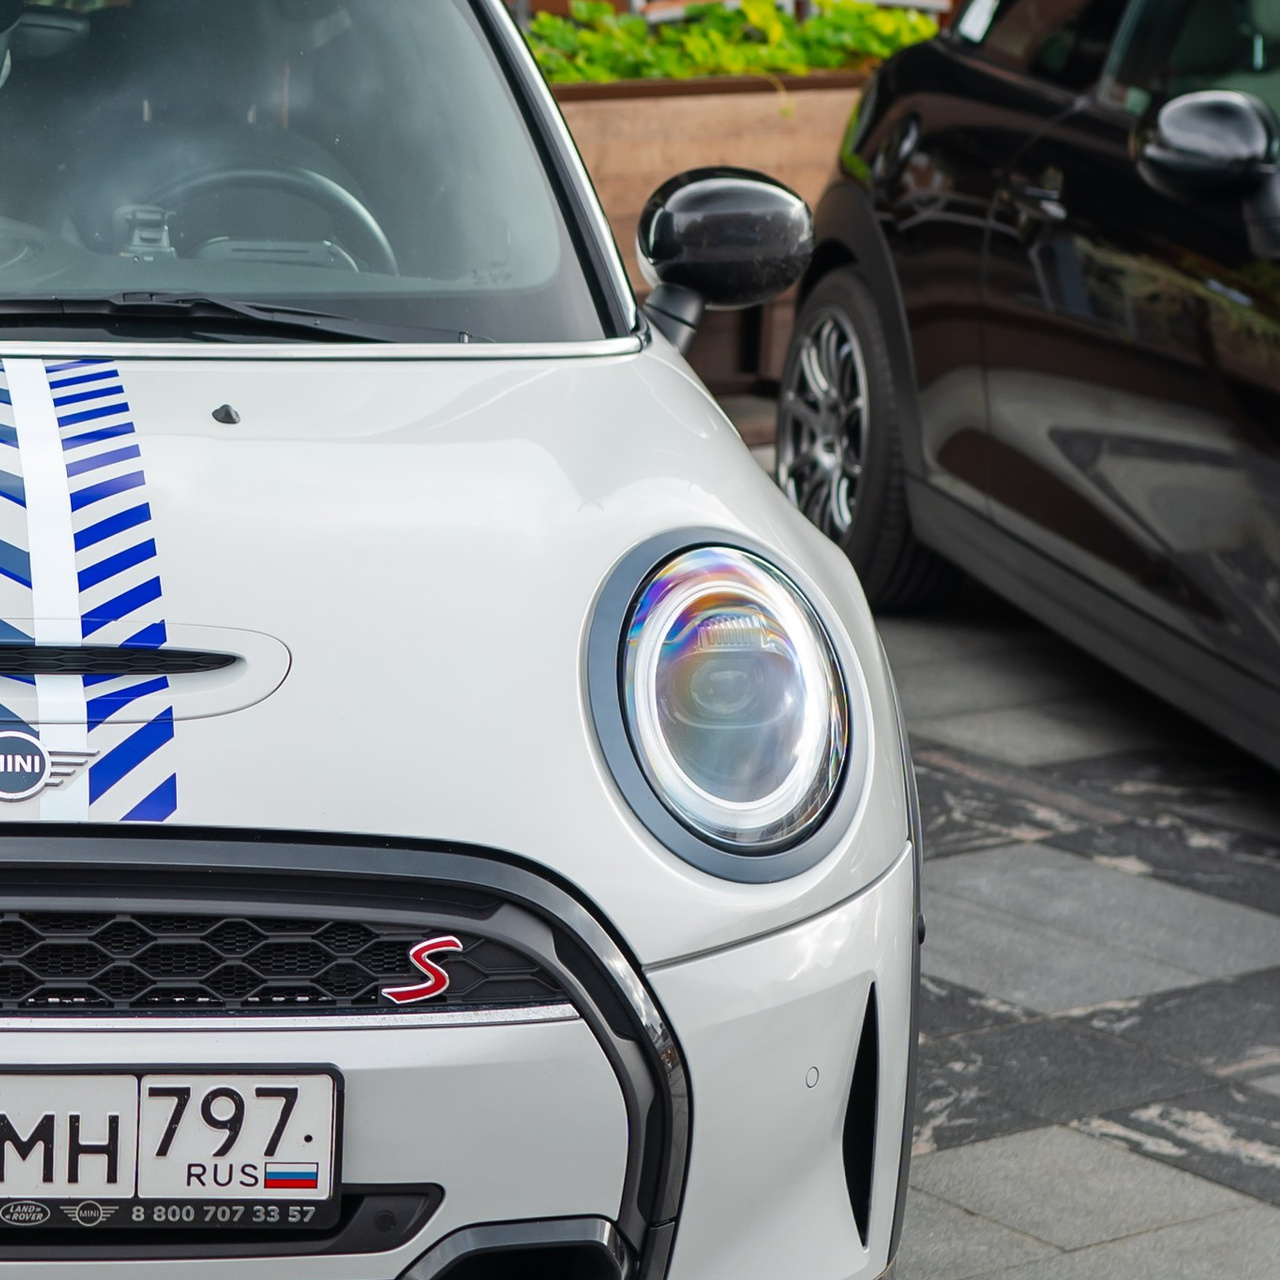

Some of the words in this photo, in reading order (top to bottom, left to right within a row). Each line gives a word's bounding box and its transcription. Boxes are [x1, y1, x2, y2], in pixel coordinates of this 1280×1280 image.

[381, 935, 464, 1005] S
[147, 1086, 300, 1158] 797
[186, 1163, 259, 1188] RUS
[9, 1205, 35, 1213] LAND
[12, 1212, 44, 1221] ROVER
[79, 1210, 100, 1218] MINI
[131, 1206, 145, 1222] 8
[153, 1206, 195, 1222] 800
[203, 1206, 245, 1222] 707
[252, 1206, 280, 1222] 33
[287, 1206, 316, 1222] 57
